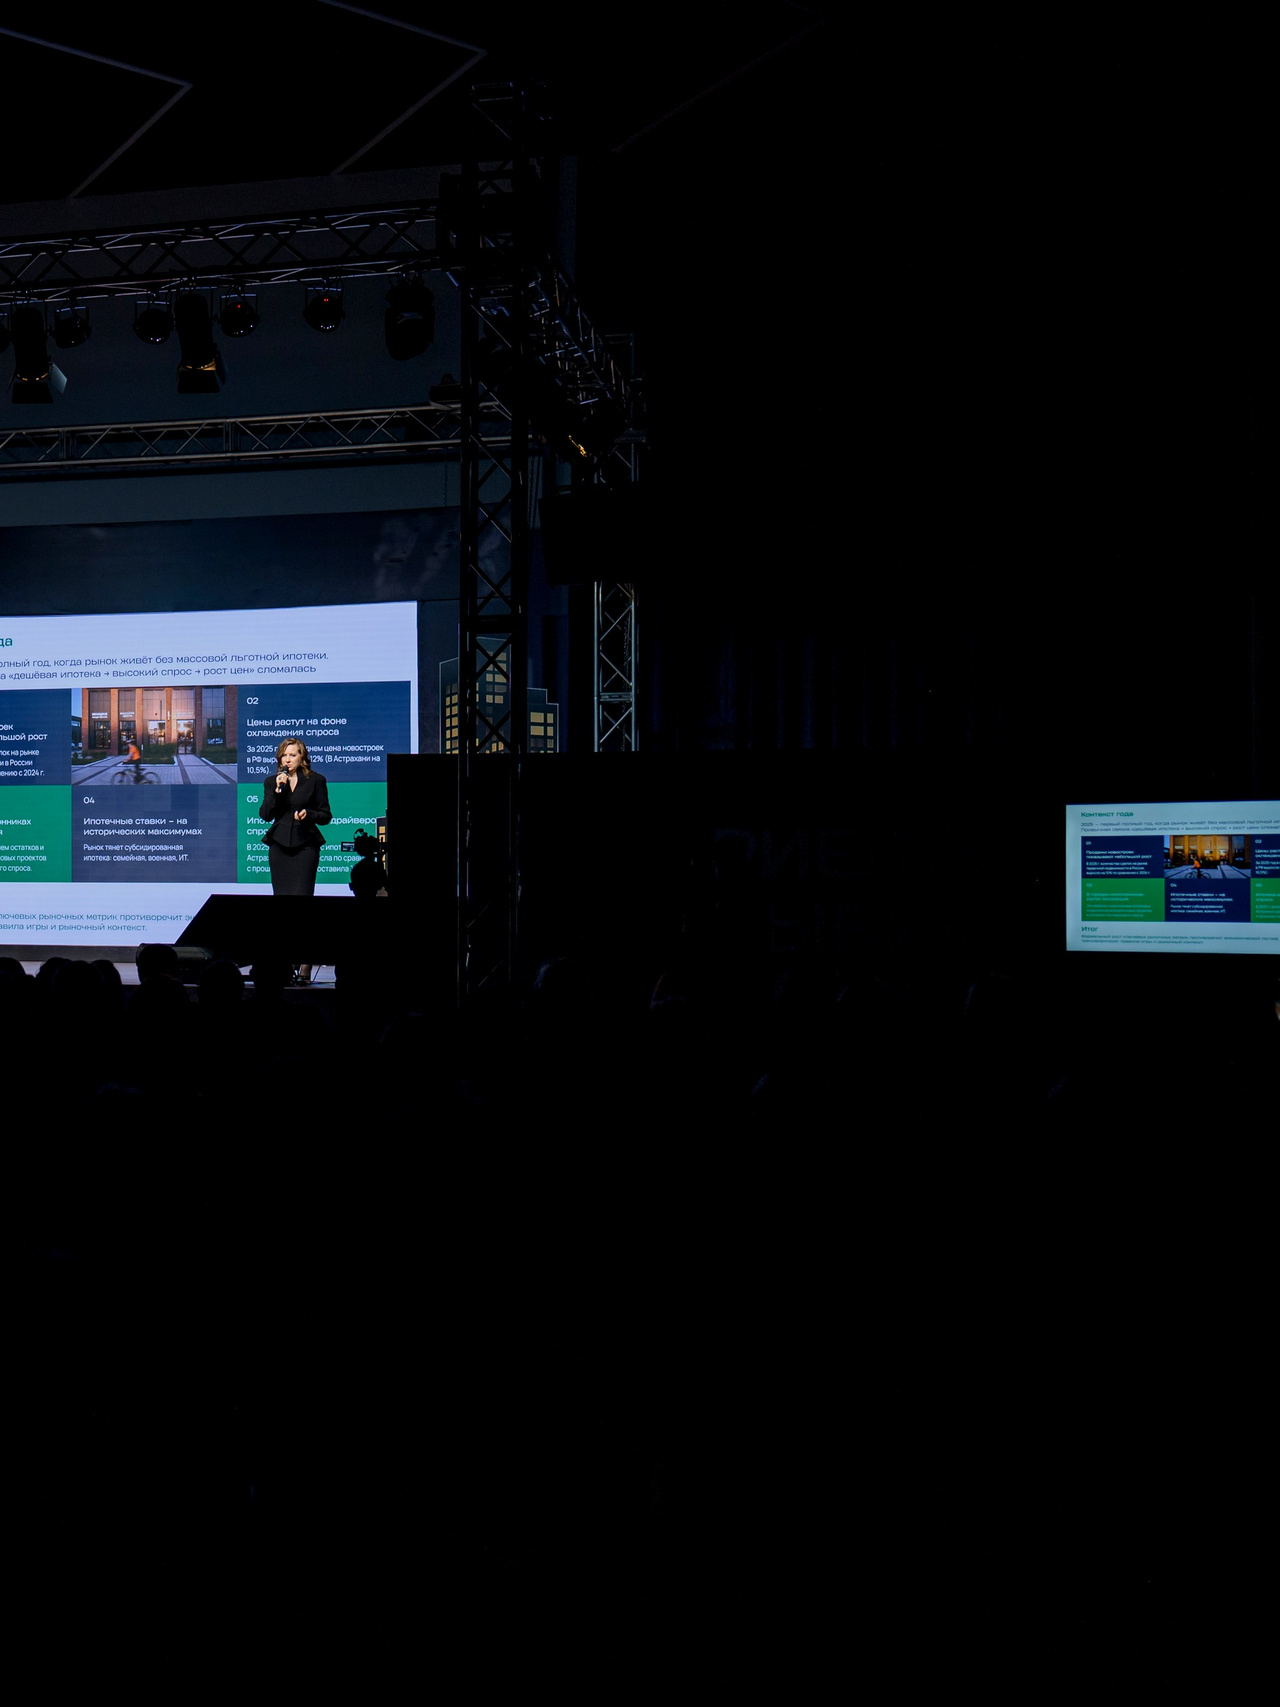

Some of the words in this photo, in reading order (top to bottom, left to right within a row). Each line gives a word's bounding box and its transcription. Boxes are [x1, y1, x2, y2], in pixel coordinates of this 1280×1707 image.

[54, 659, 82, 667] когда
[85, 658, 118, 667] рынок
[120, 656, 153, 665] живёт
[155, 655, 174, 664] без
[177, 654, 228, 663] массовой
[231, 652, 280, 662] льготной
[9, 671, 58, 681] «дешёвая
[60, 671, 101, 679] ипотека
[113, 668, 158, 677] высокий
[161, 669, 192, 677] спрос
[204, 668, 228, 676] рост
[230, 667, 255, 675] цен»
[257, 666, 317, 674] сломалась
[247, 697, 259, 705] 02
[247, 719, 273, 727] Цены
[275, 719, 305, 727] растут
[320, 717, 347, 726] фоне
[306, 729, 340, 737] спроса
[247, 745, 256, 753] За
[256, 745, 273, 753] 2025
[343, 745, 384, 753] новостроек
[310, 755, 324, 763] 12%
[325, 755, 333, 763] (В
[333, 755, 371, 764] Астрахани
[247, 795, 259, 803] 05
[84, 829, 146, 837] исторических
[124, 844, 184, 852] субсидированная
[17, 855, 47, 863] проектов
[86, 914, 118, 922] метрик
[120, 914, 183, 922] противоречит
[59, 923, 105, 932] рыночный
